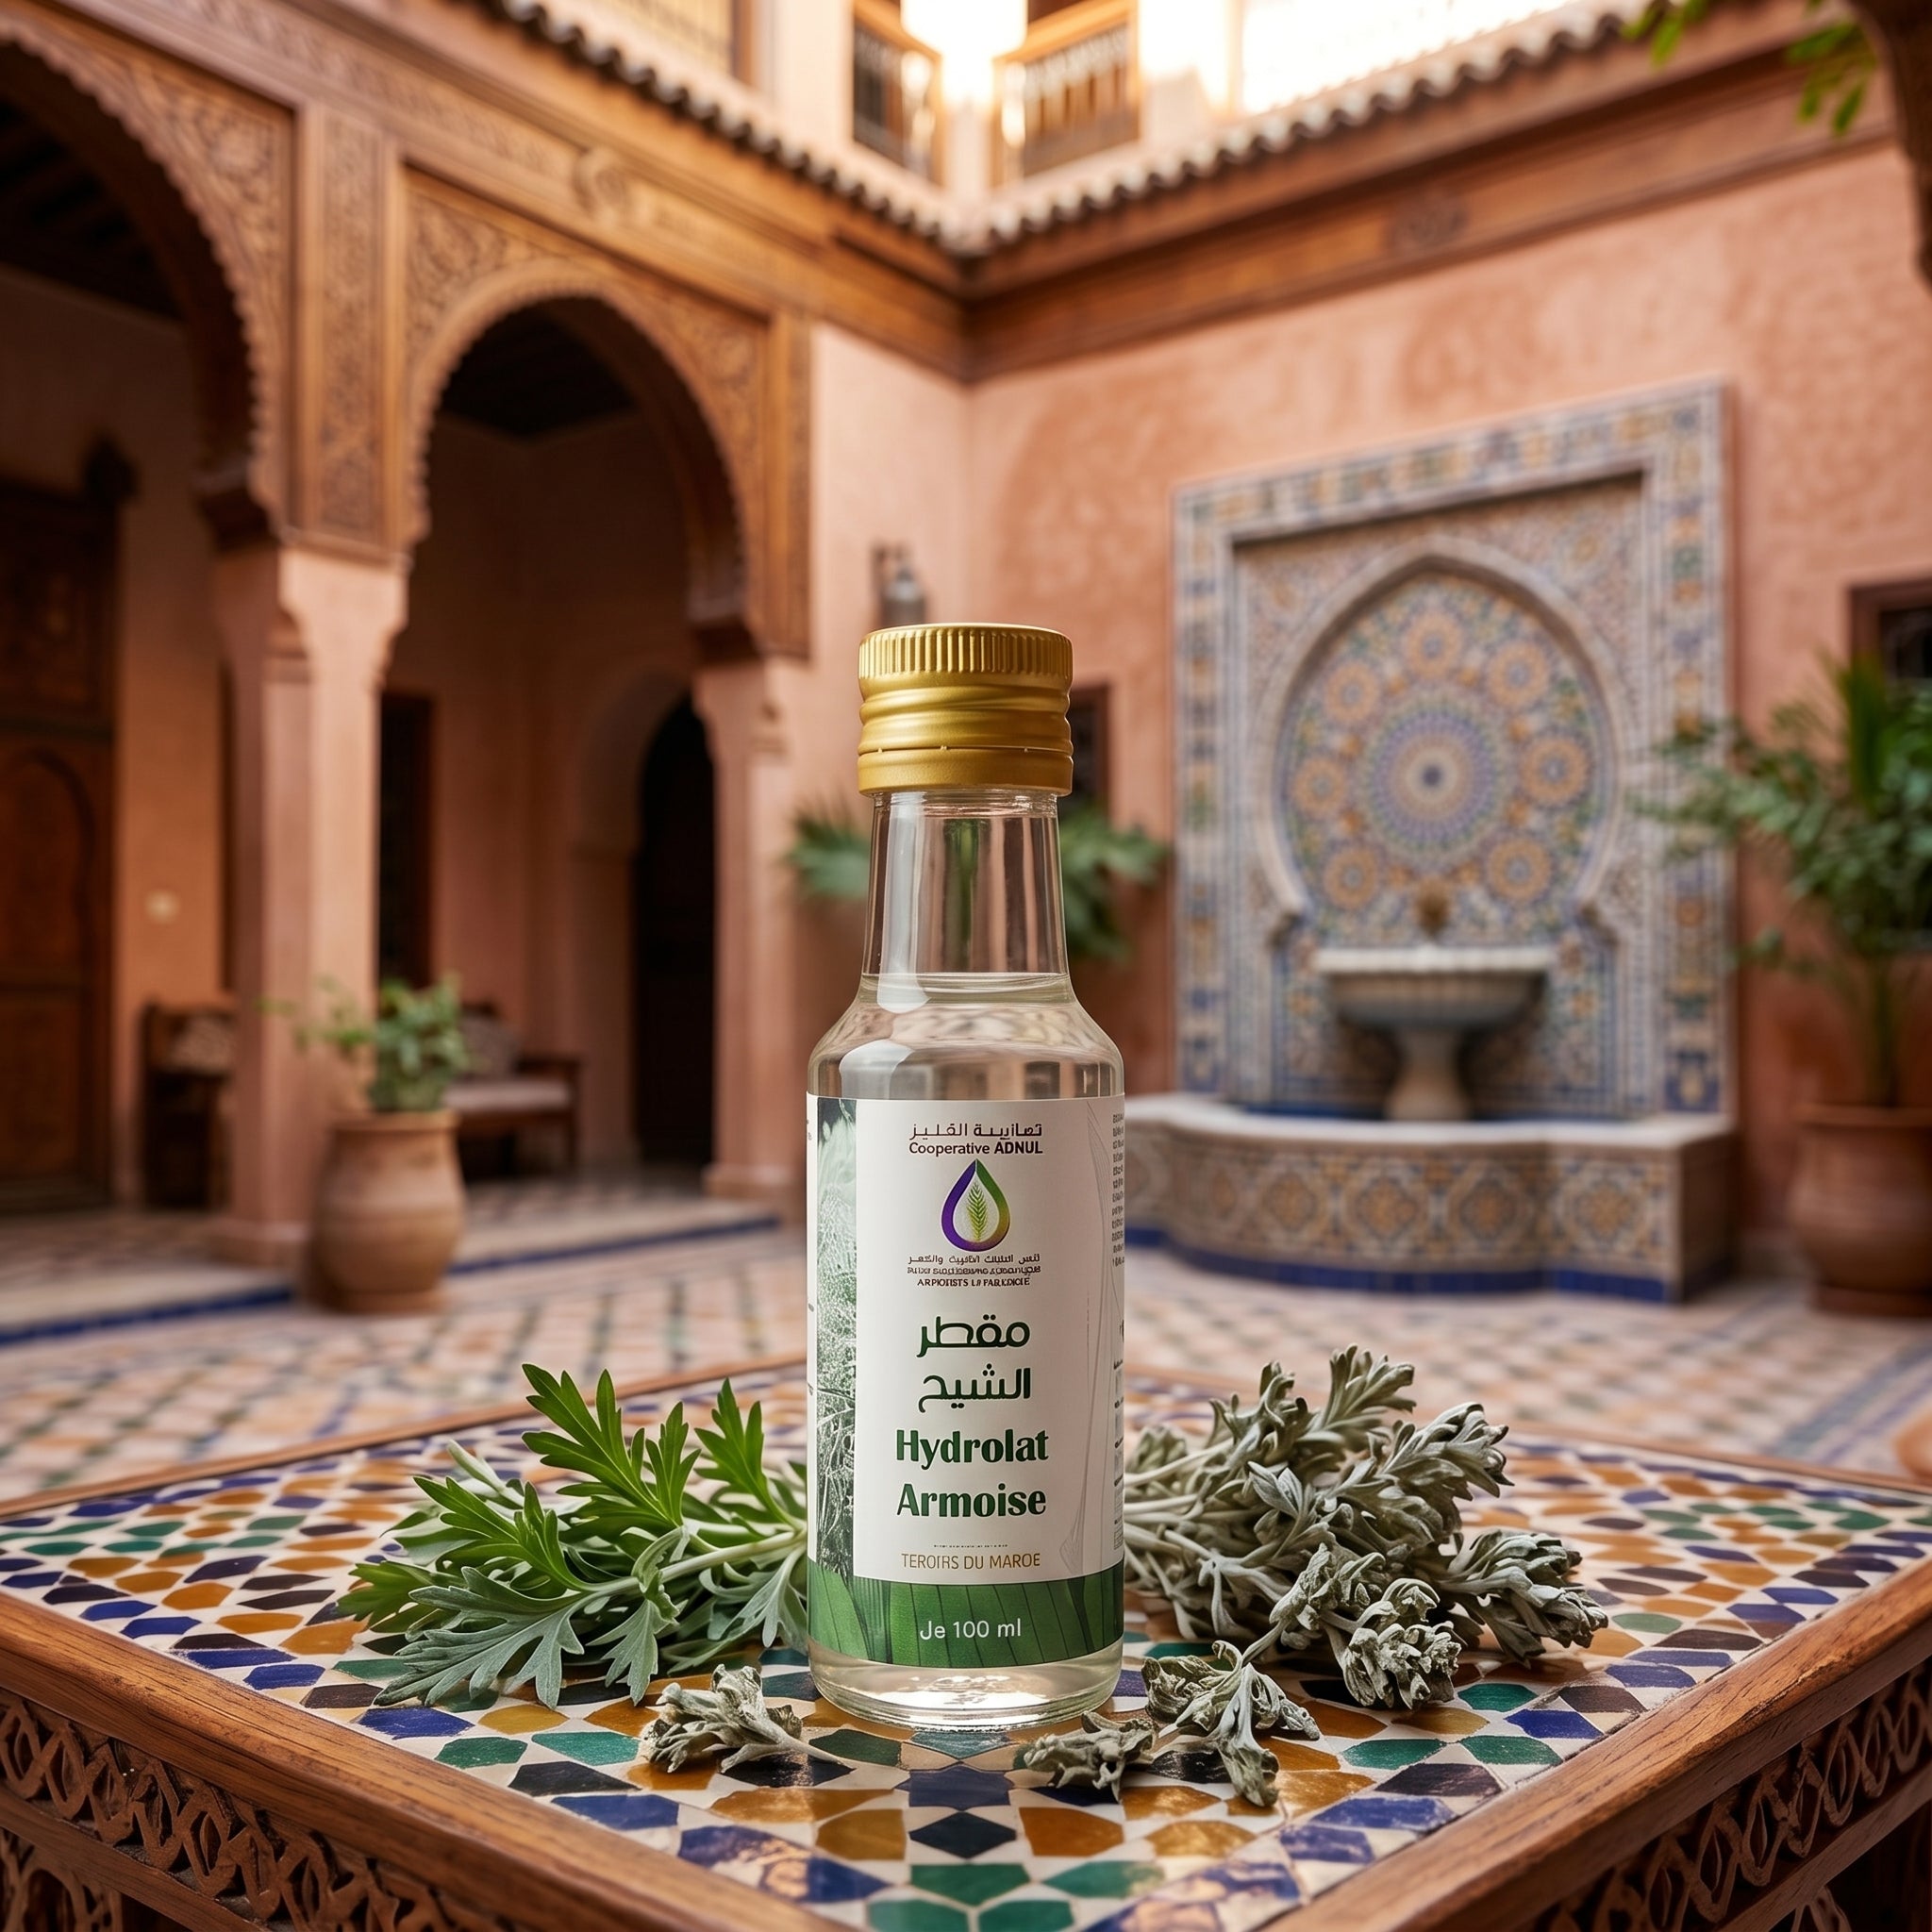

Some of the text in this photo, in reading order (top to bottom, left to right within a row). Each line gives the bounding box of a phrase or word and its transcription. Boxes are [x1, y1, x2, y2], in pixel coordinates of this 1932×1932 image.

[908, 1141, 1043, 1158] Cooperative ADNUL
[916, 1314, 1031, 1357] مقطر
[918, 1363, 1031, 1413] الشيح
[896, 1428, 1049, 1471] Hydrolat
[896, 1482, 1046, 1518] Armoise
[963, 1556, 984, 1570] DU
[919, 1617, 1022, 1641] Je 100 ml
